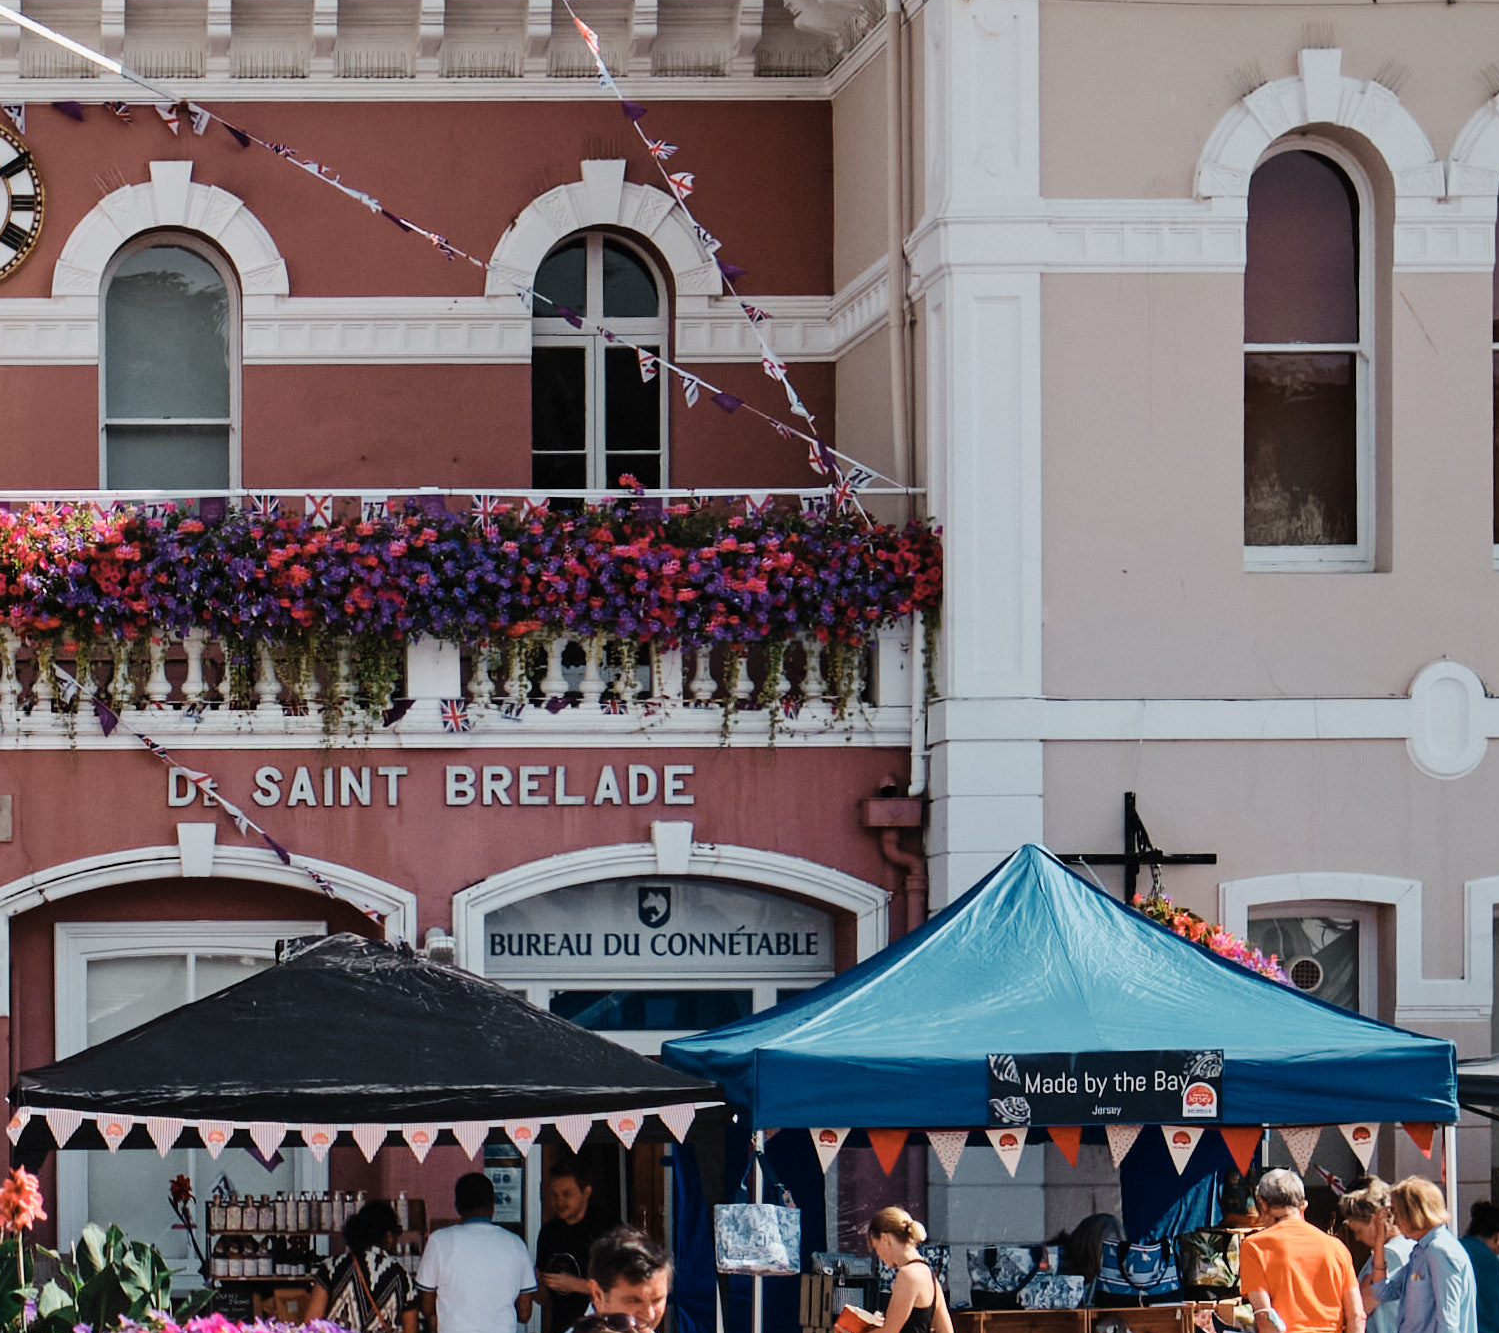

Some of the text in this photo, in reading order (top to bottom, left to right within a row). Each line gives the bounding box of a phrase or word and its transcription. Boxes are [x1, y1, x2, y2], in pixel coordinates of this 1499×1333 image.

[251, 765, 408, 808] SAINT
[444, 764, 696, 807] BRELADE
[490, 925, 818, 956] BUREAU DU CONNÉTABLE
[1025, 1070, 1190, 1098] Made by the Bay
[1091, 1104, 1122, 1117] Jersey
